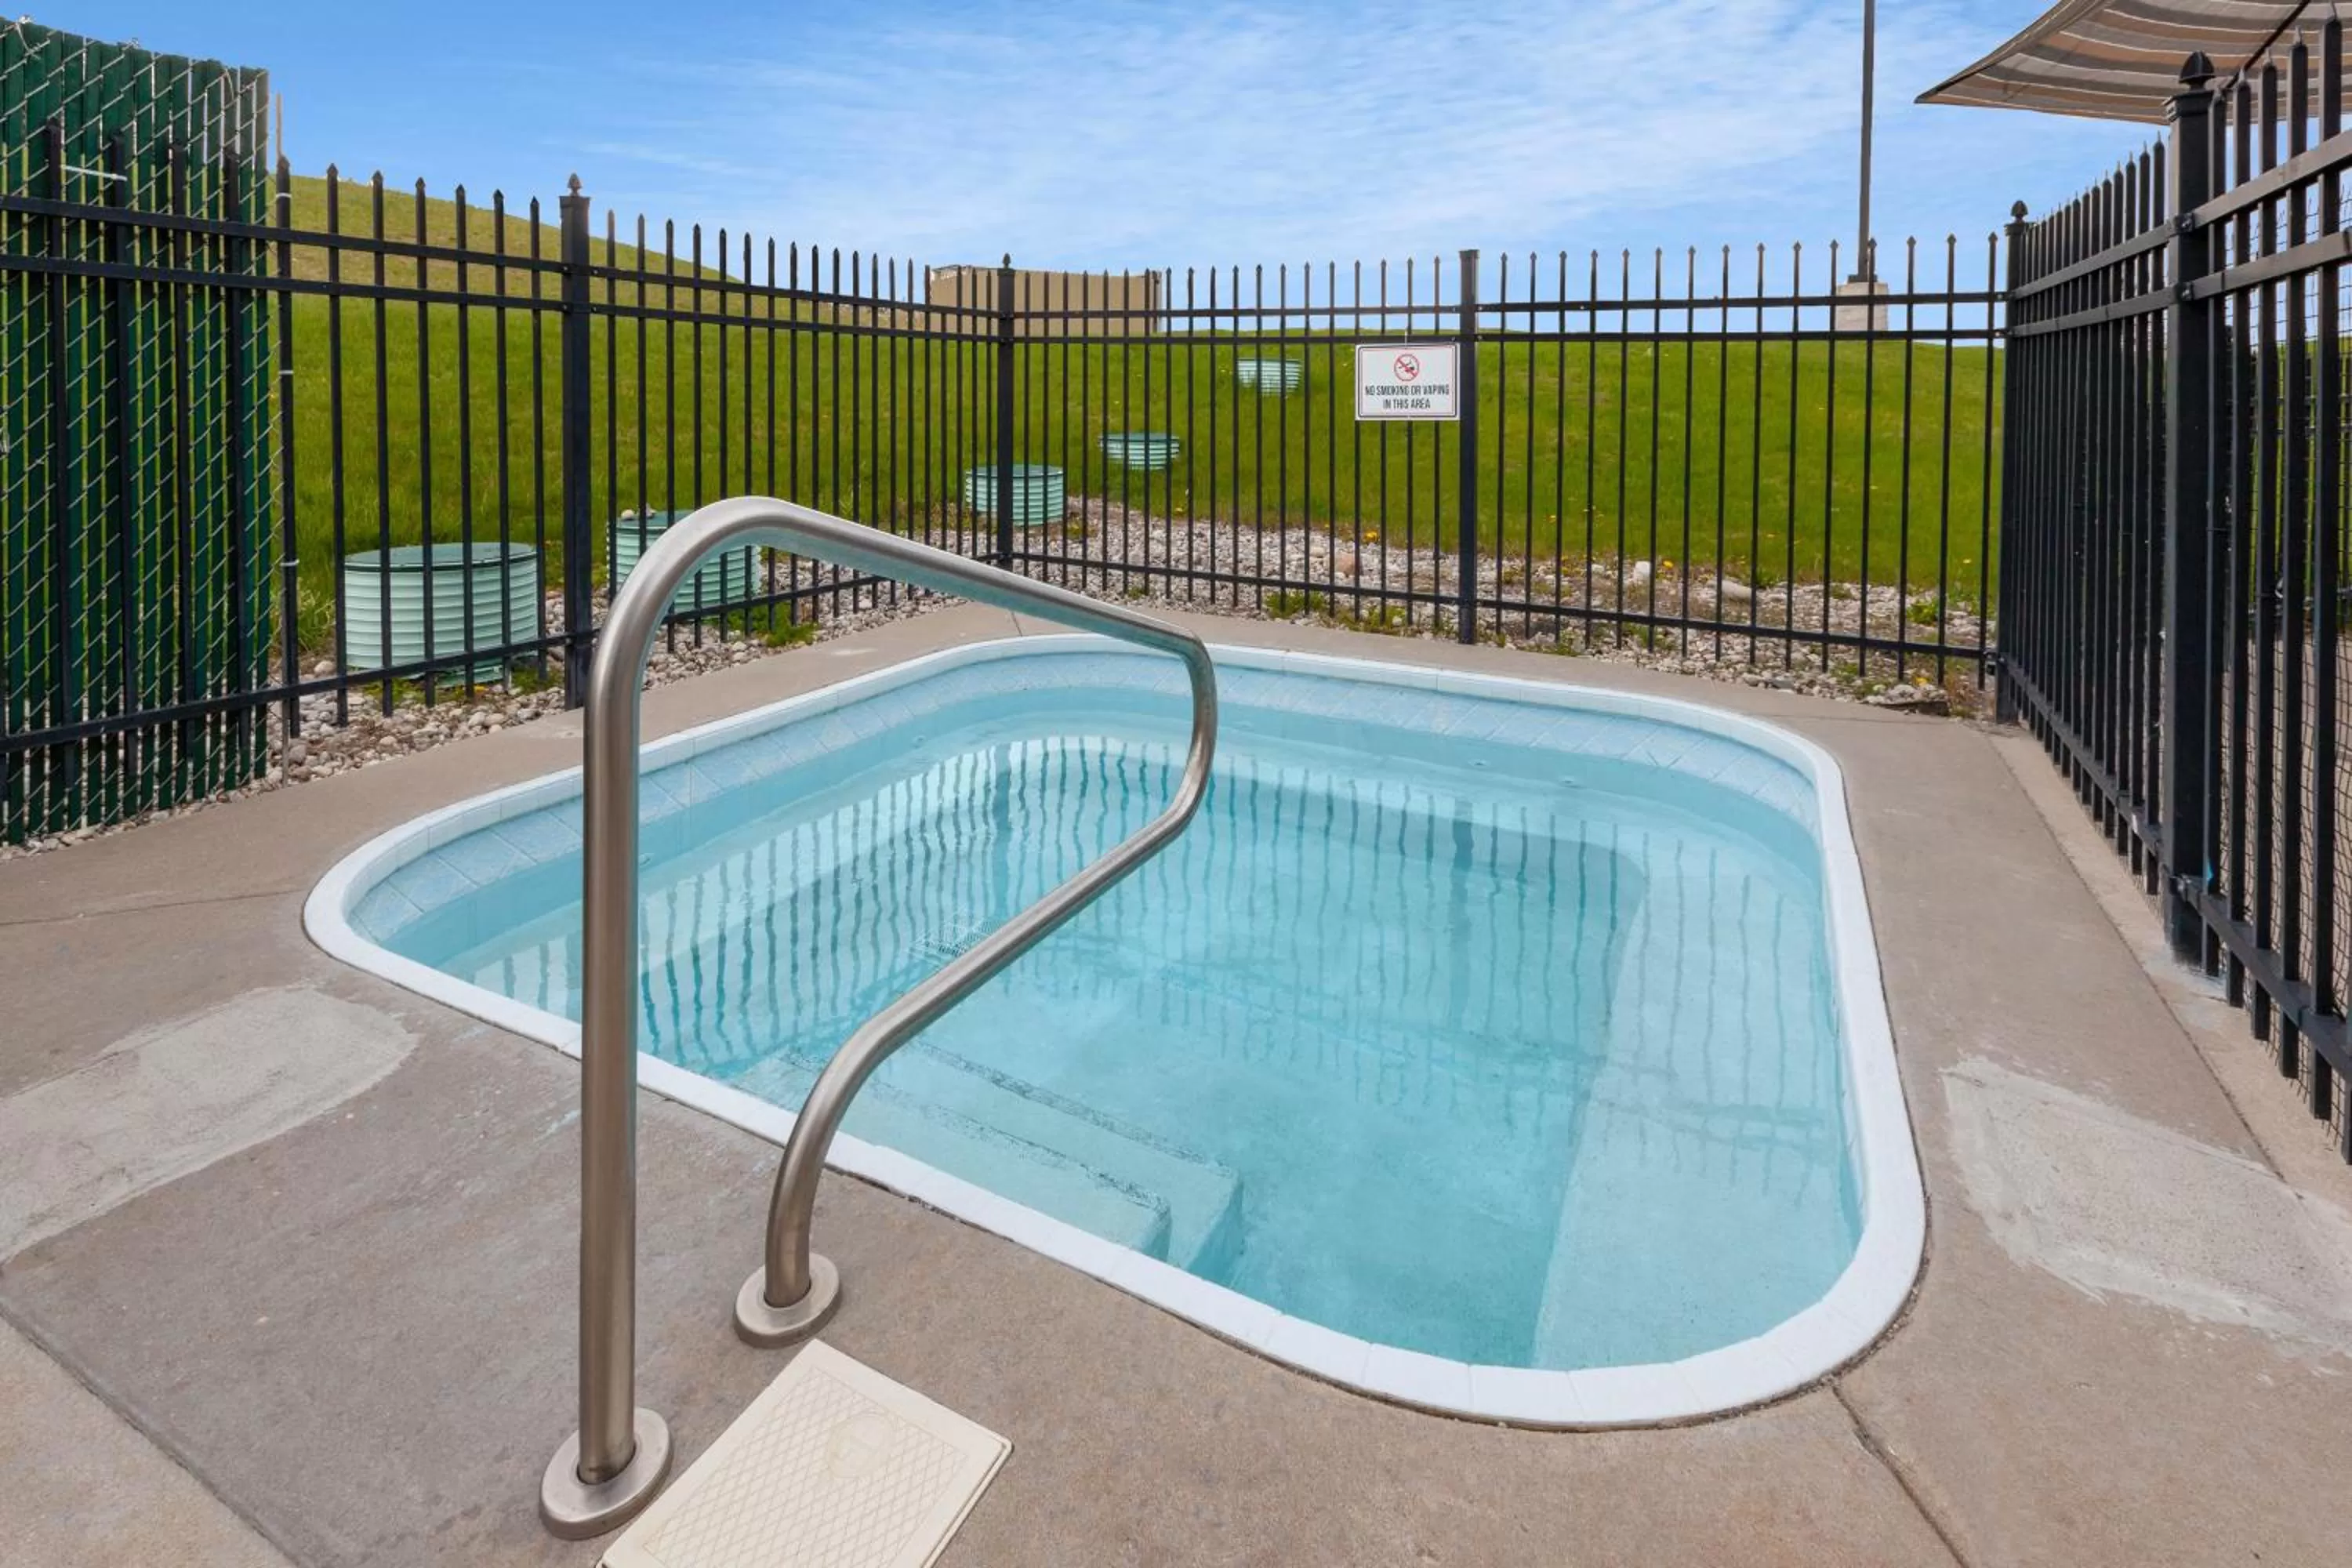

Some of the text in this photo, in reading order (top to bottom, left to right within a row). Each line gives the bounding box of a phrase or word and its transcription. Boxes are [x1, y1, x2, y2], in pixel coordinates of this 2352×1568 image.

[1365, 384, 1449, 396] NO SMOKING OR VAPING
[1383, 397, 1431, 409] IN THIS AREA
